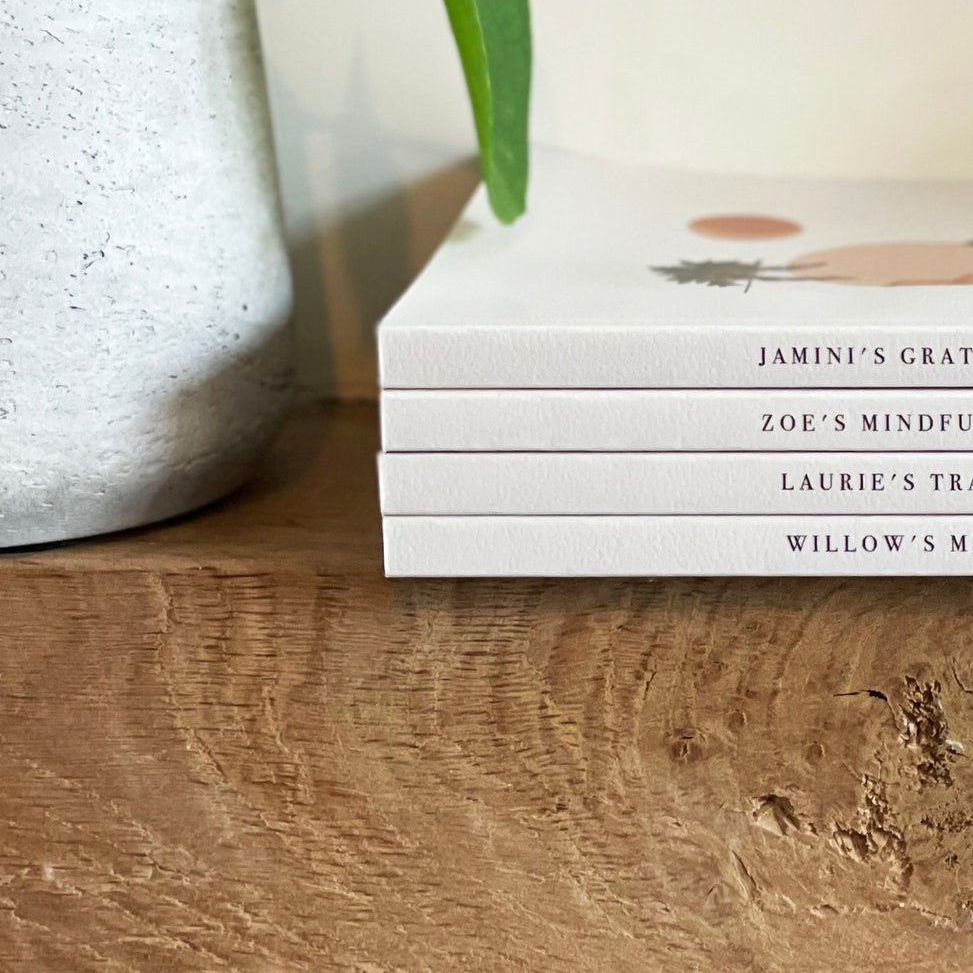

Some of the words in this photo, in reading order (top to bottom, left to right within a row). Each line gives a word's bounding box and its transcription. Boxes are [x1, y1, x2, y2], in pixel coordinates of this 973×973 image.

[758, 346, 886, 367] JAMINI'S
[761, 413, 846, 431] ZOE'S
[781, 472, 915, 490] LAURIE'S
[786, 534, 935, 552] WILLOW'S
